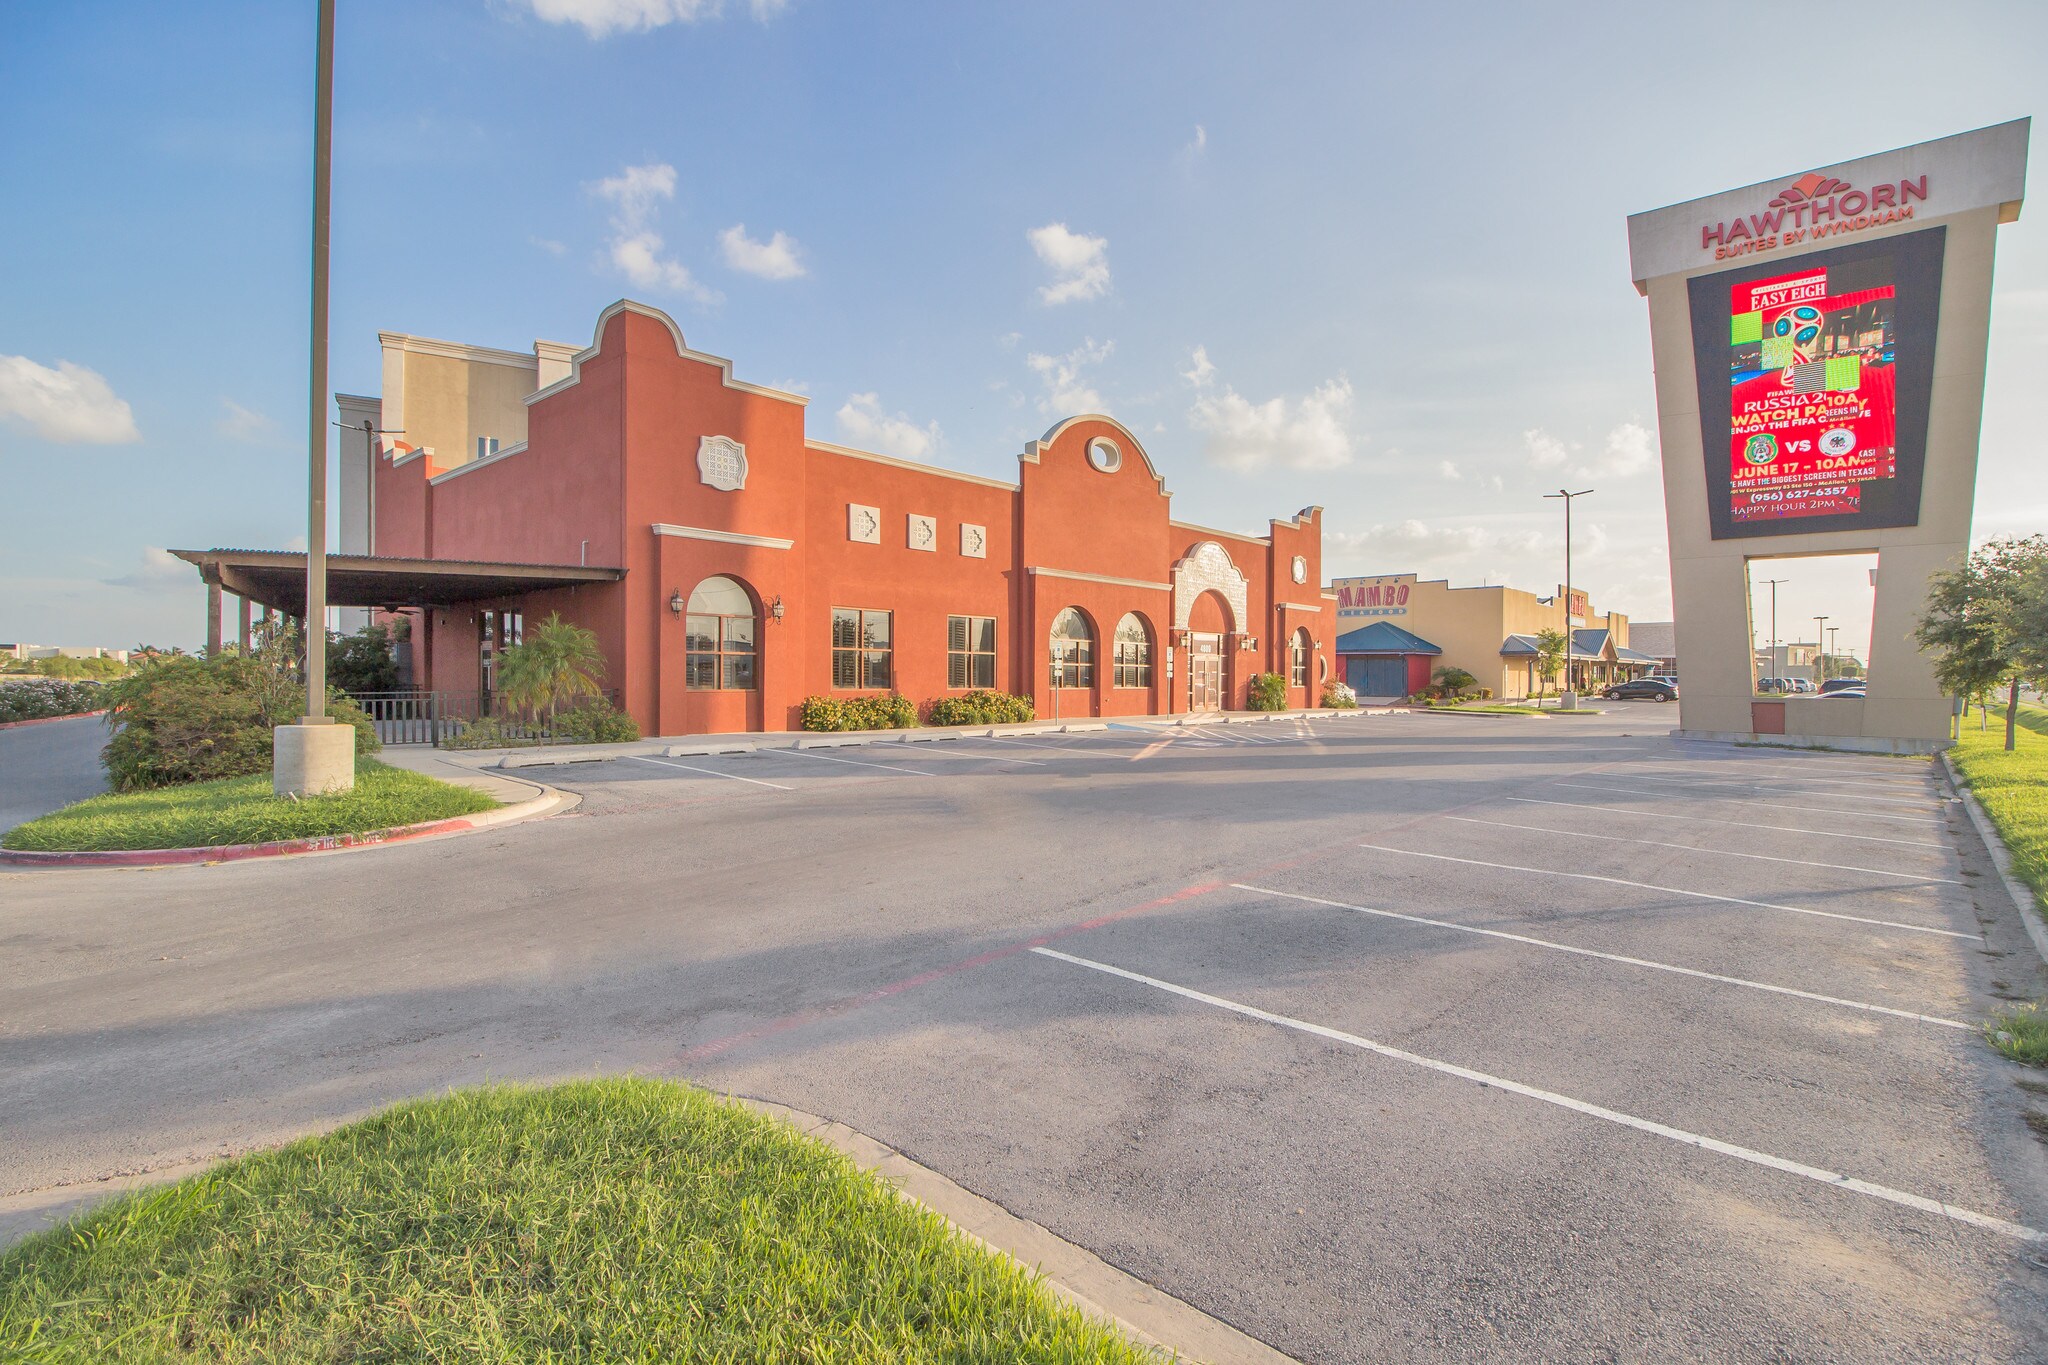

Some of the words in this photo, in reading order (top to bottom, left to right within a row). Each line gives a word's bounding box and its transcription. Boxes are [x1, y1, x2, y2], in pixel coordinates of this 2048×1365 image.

[1702, 175, 1927, 249] HAWTHORN
[1715, 236, 1777, 260] SUITES
[1783, 229, 1806, 246] BY
[1810, 206, 1914, 239] WYNDHAM
[1751, 290, 1788, 311] EASY
[1744, 395, 1810, 412] RUSSIA
[1767, 390, 1784, 398] FIFA
[1730, 423, 1766, 435] ENJOY
[1768, 421, 1789, 430] THE
[1792, 417, 1816, 427] FIFA
[1731, 407, 1799, 427] WATCH
[1785, 439, 1811, 453] VS
[1733, 464, 1779, 479] JUNE
[1783, 462, 1799, 473] 17
[1816, 455, 1861, 470] 10AM
[1738, 479, 1756, 487] HAVE
[1758, 477, 1770, 485] THE
[1772, 474, 1802, 484] BIGGEST
[1803, 471, 1837, 481] SCREENS
[1838, 470, 1846, 478] IN
[1848, 467, 1876, 476] TEXAS!
[1751, 491, 1783, 503] (956)
[1786, 486, 1848, 499] 627-6357
[1771, 502, 1806, 511] HOUR
[1810, 500, 1835, 508] 2PM
[1337, 585, 1409, 608] MAMBO
